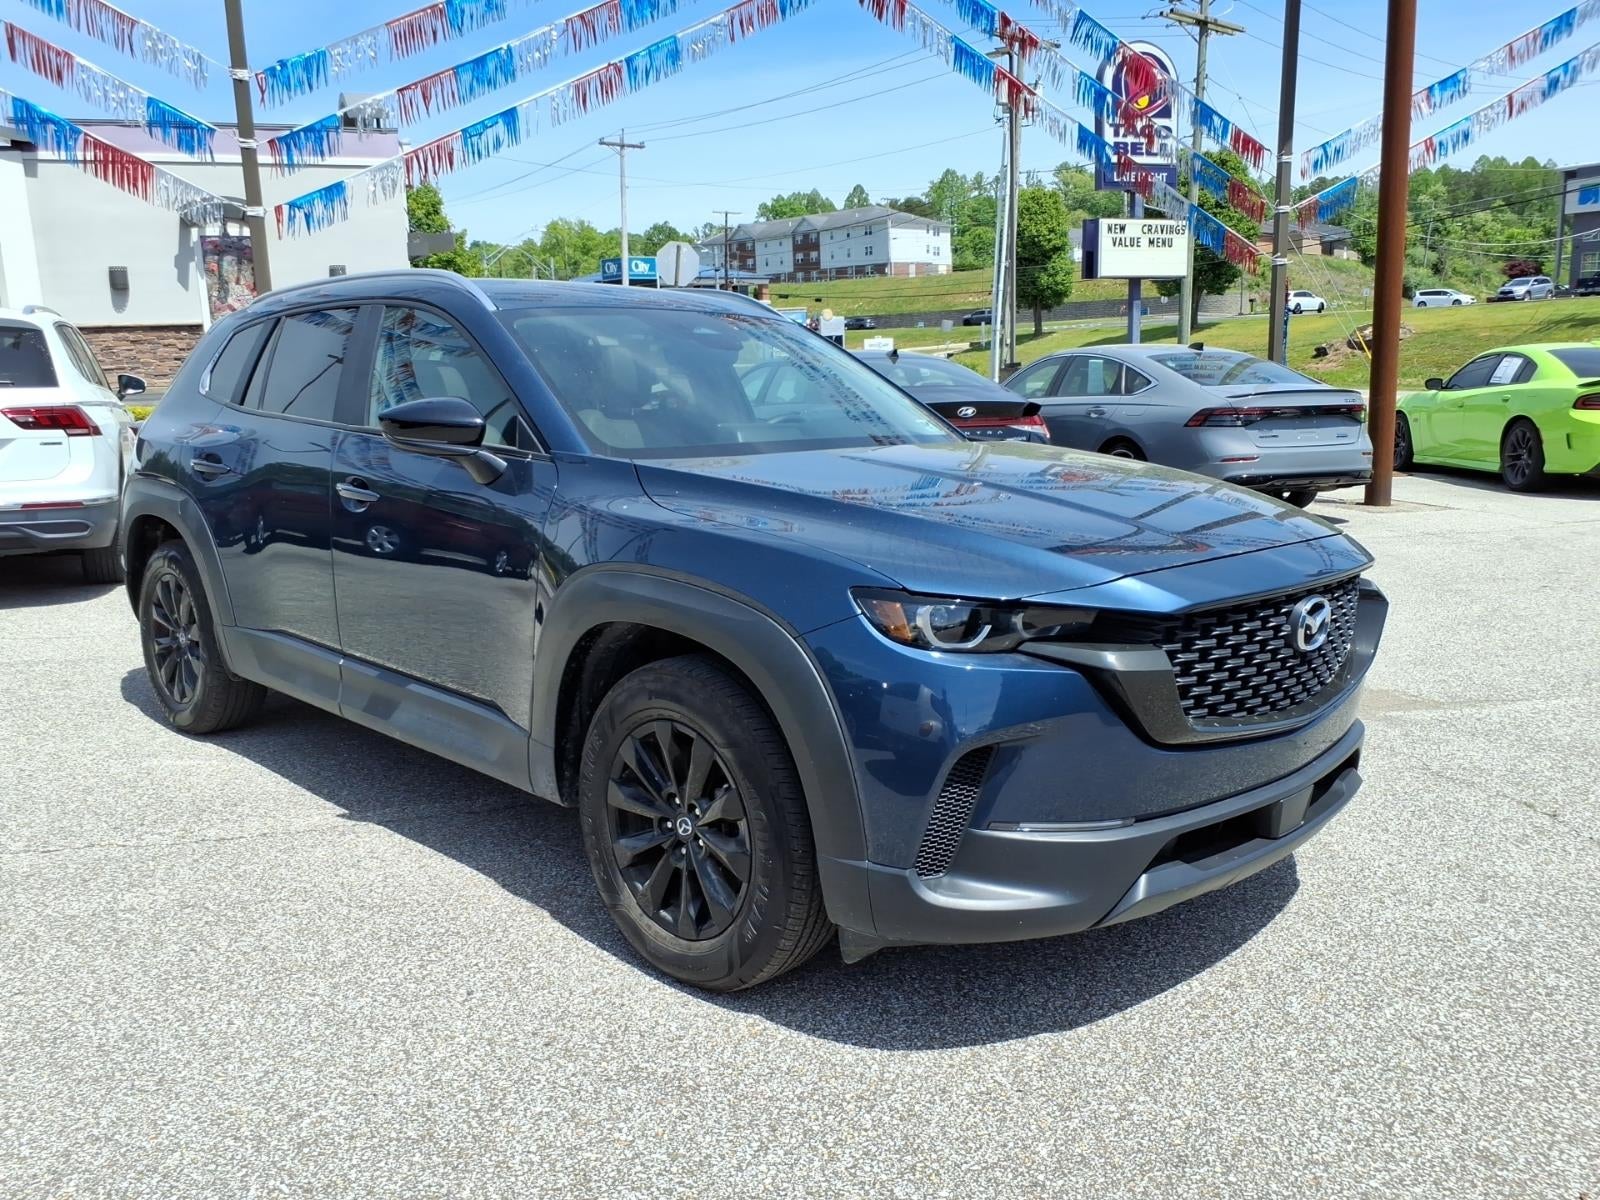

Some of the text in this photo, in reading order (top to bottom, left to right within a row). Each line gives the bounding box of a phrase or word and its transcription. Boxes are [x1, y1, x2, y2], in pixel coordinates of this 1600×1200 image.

[1137, 171, 1167, 181] NGHT
[1107, 223, 1187, 235] NEW CRAVINGS
[1112, 237, 1173, 248] VALUE MENU
[631, 260, 650, 274] City
